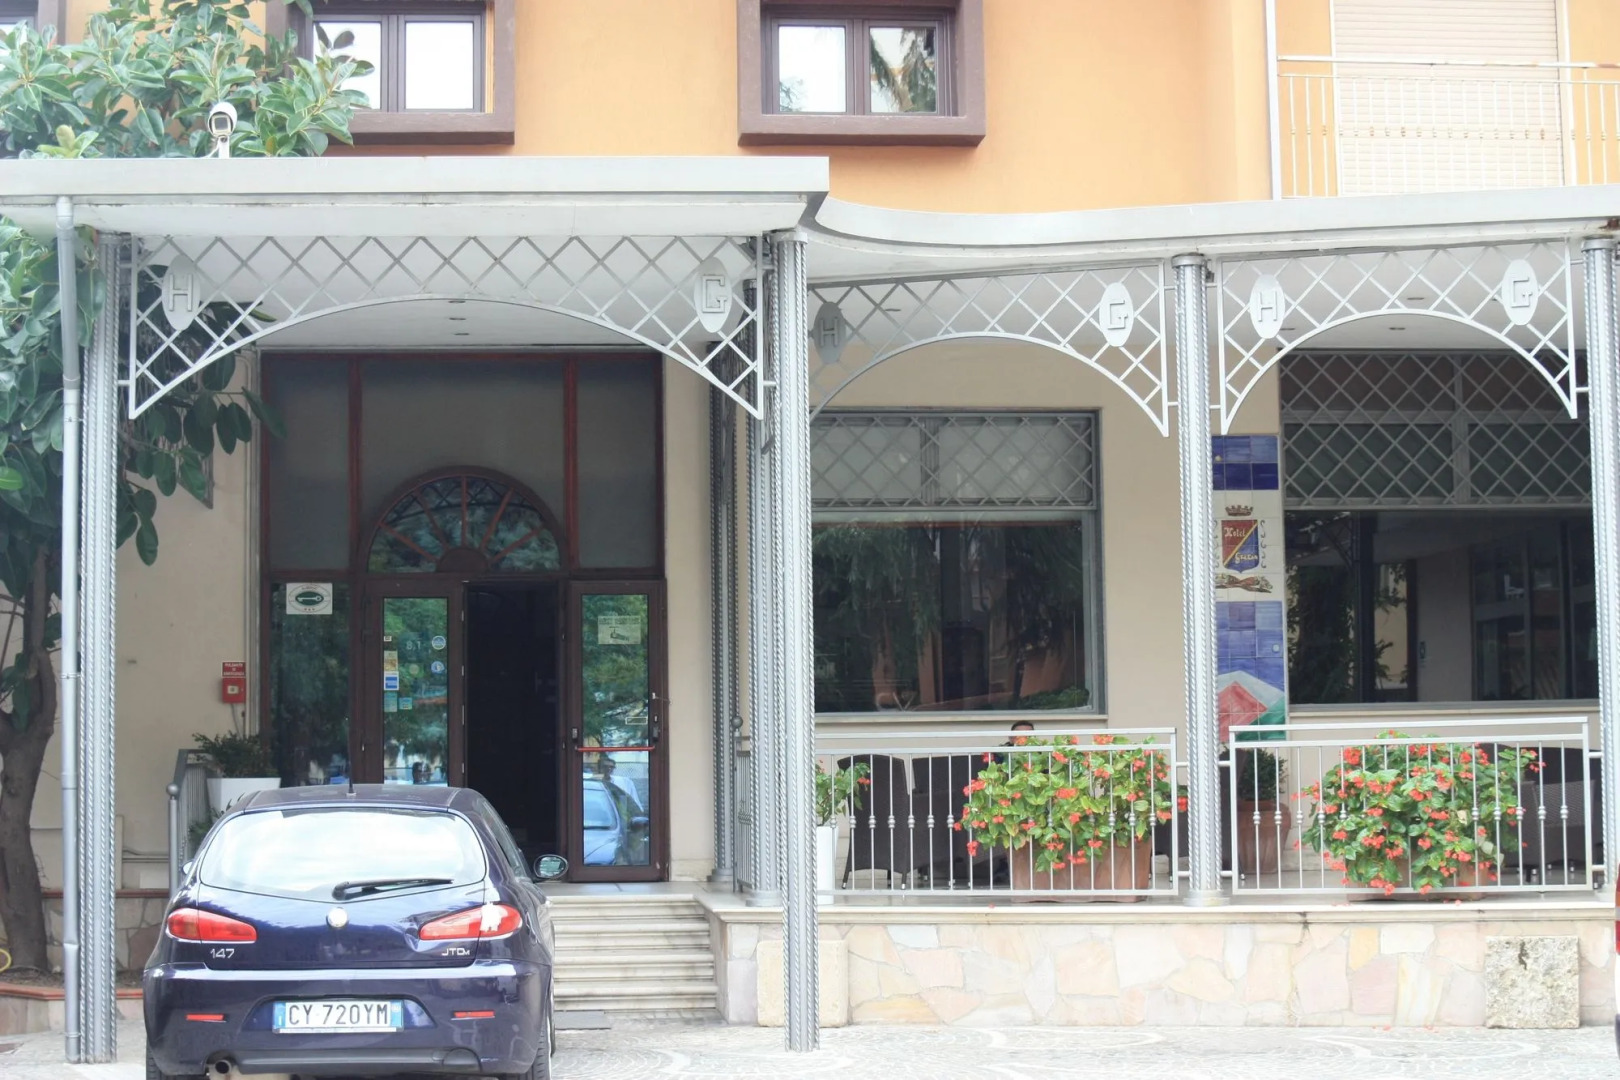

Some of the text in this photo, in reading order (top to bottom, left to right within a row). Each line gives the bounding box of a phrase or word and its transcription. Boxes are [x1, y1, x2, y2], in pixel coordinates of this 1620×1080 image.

[168, 272, 193, 312] H
[701, 275, 728, 313] G
[1257, 290, 1278, 323] H
[1509, 273, 1533, 309] G
[1106, 296, 1129, 331] G
[819, 316, 840, 347] H
[210, 948, 235, 959] 147
[289, 1003, 389, 1026] CY 720YM
